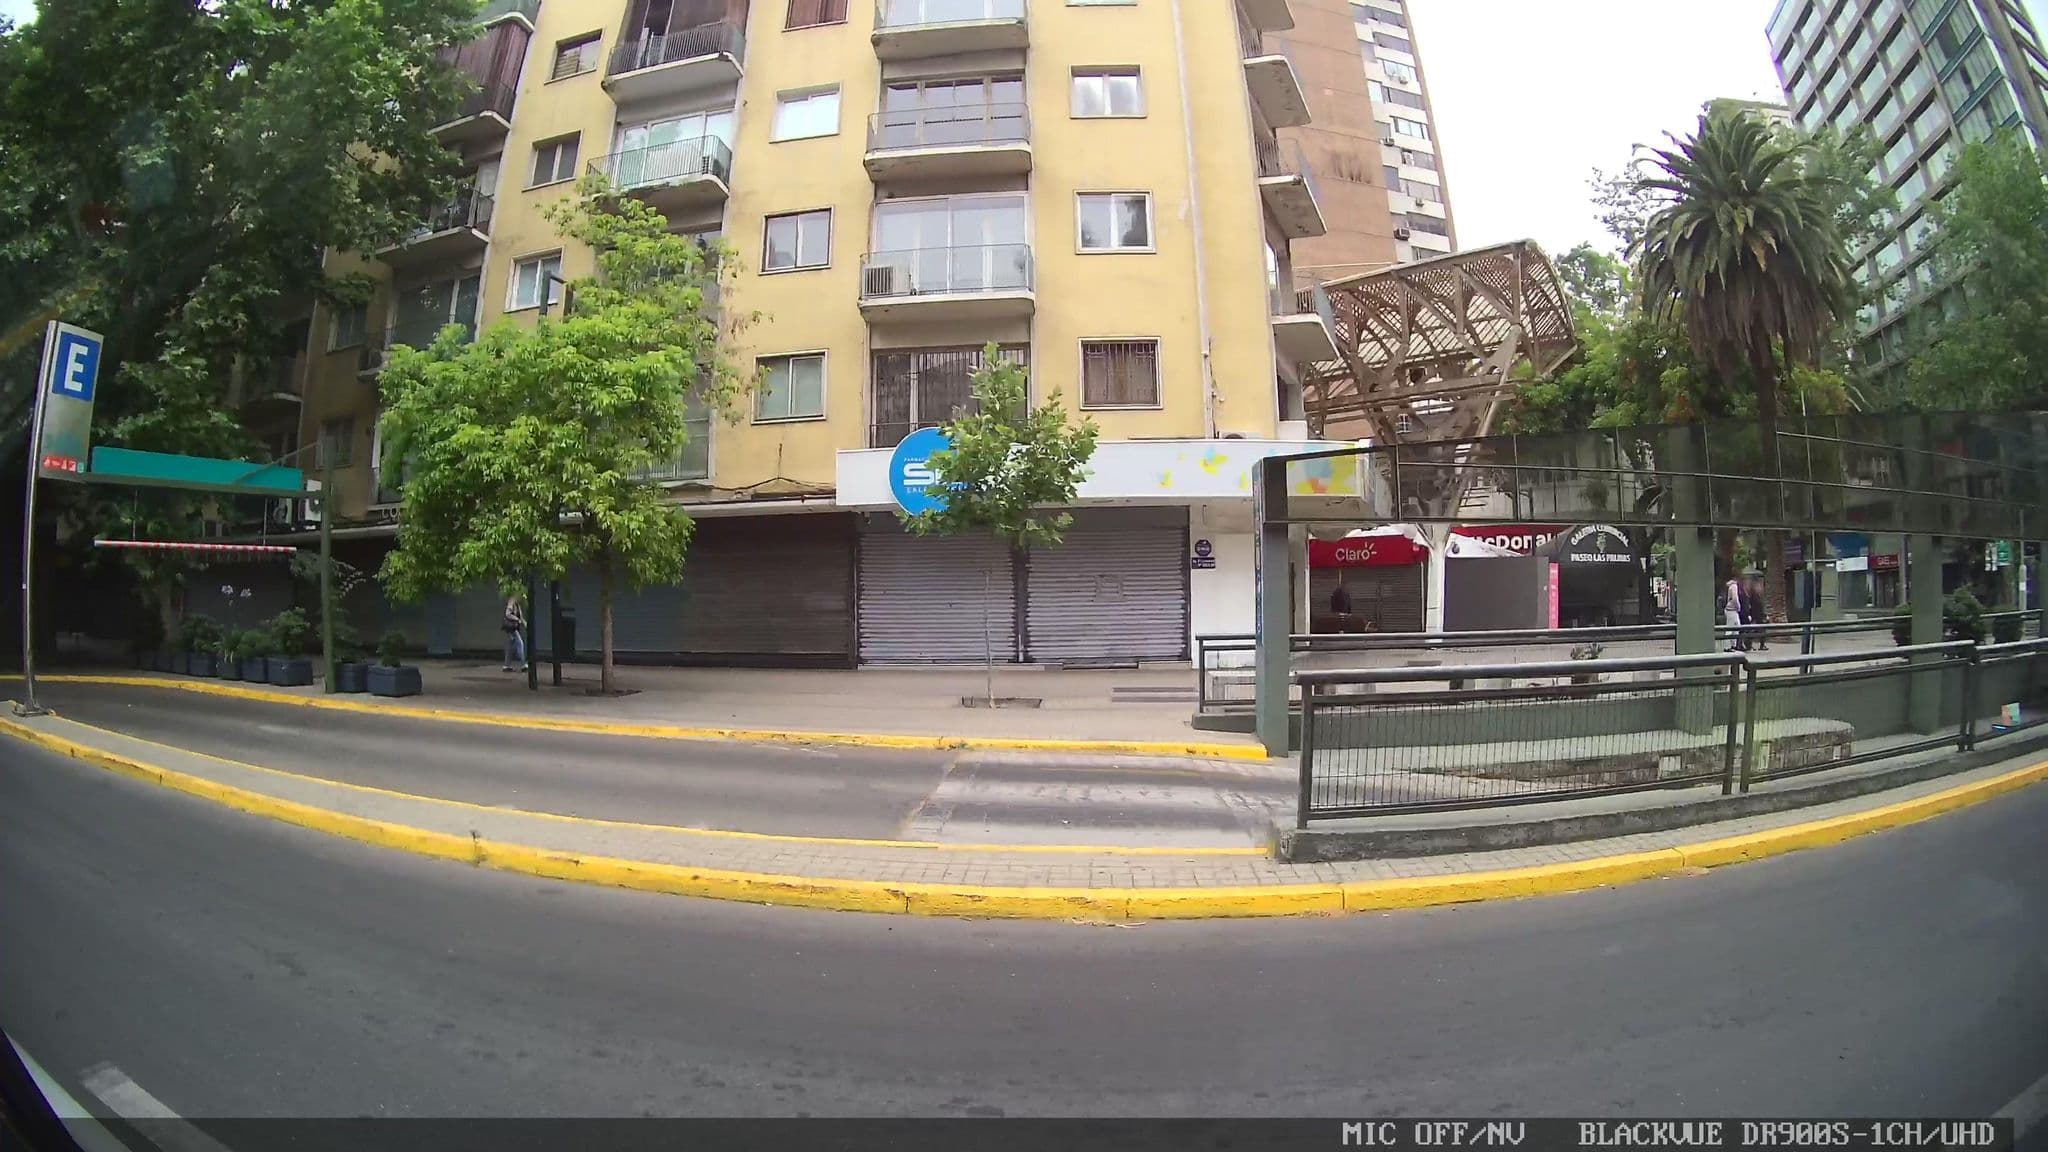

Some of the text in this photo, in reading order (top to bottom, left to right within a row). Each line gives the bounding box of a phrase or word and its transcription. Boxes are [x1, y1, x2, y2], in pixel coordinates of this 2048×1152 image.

[64, 342, 89, 393] E
[1335, 545, 1373, 561] Claro
[1570, 553, 1631, 562] PASEO LAS PALMAS
